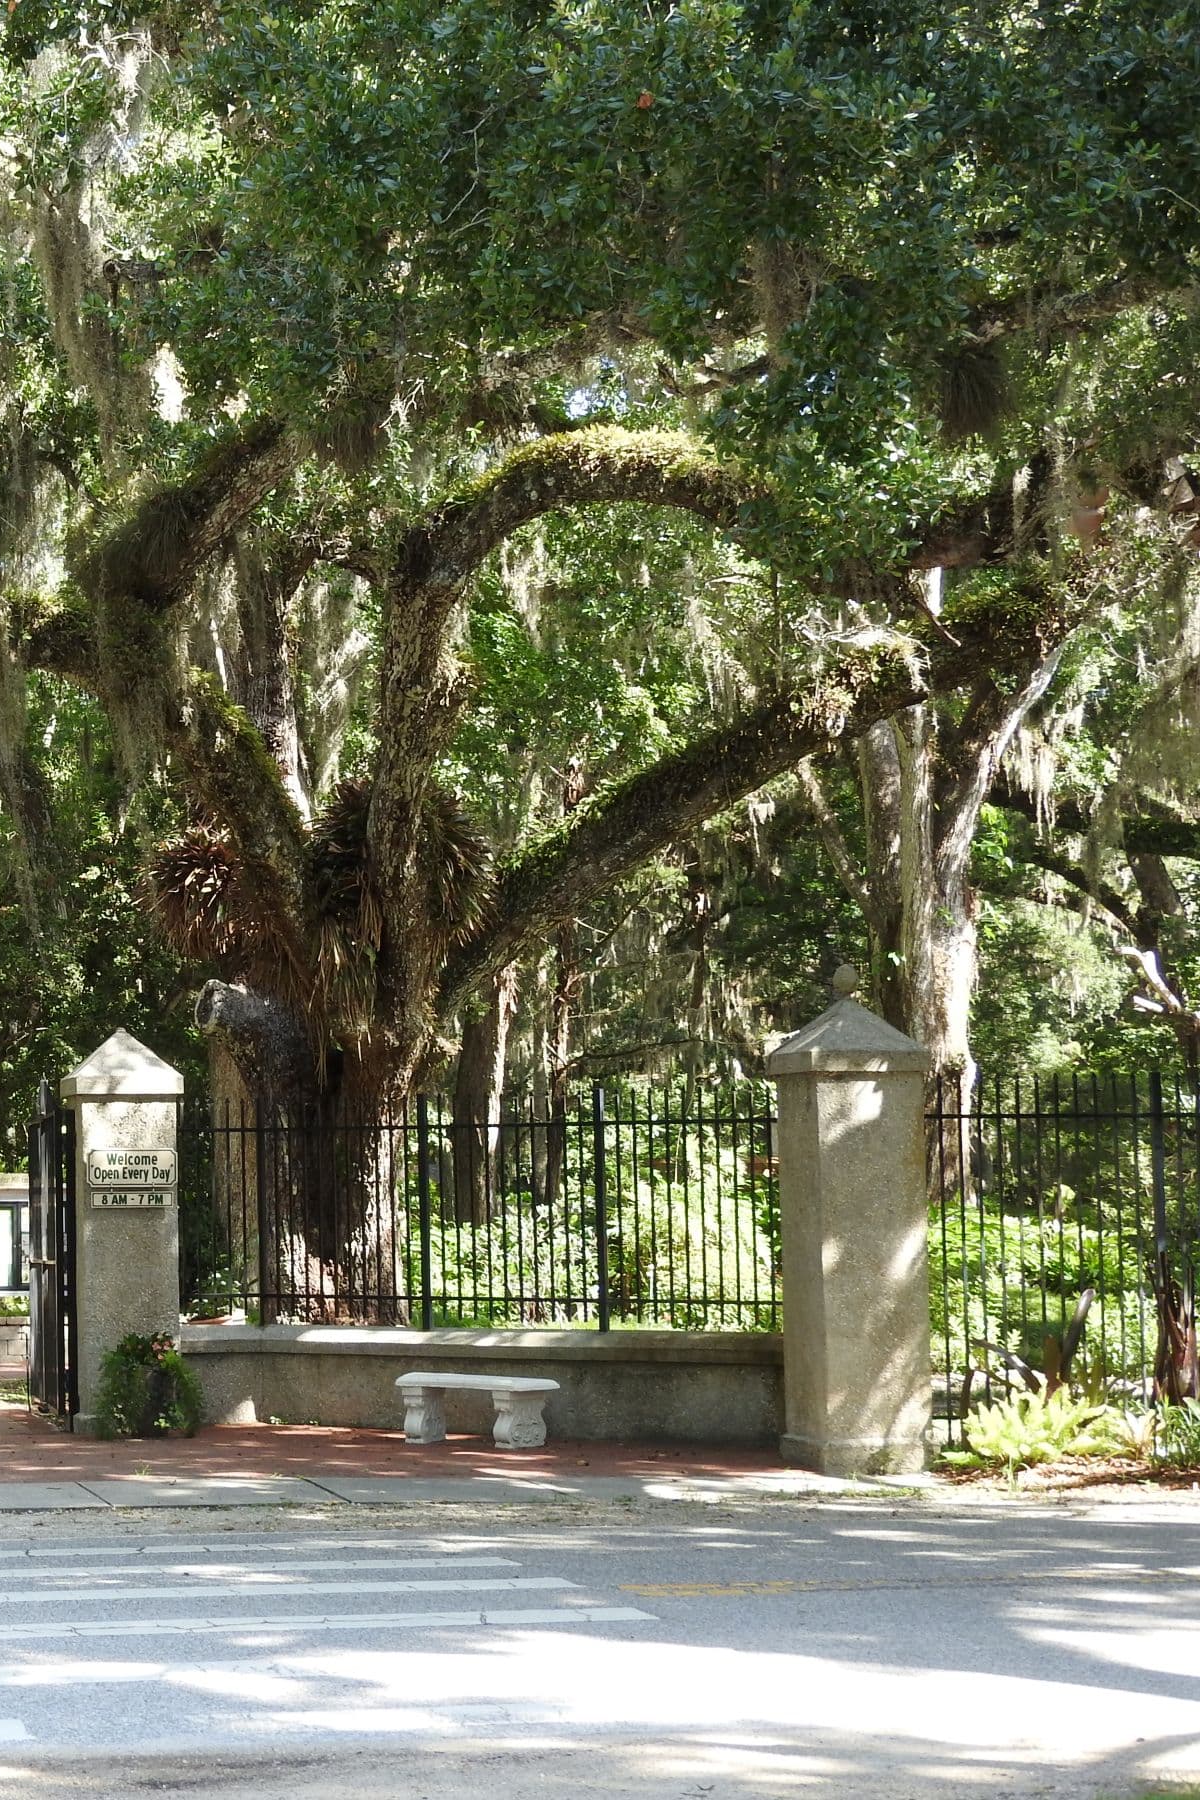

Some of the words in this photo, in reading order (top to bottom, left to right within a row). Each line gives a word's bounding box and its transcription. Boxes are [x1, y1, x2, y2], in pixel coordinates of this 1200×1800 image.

[106, 1153, 158, 1166] Welcome
[93, 1167, 120, 1182] Open
[122, 1167, 149, 1182] Every
[152, 1167, 171, 1182] Day
[101, 1194, 108, 1205] 8
[111, 1194, 128, 1205] AM
[138, 1194, 145, 1205] 7
[147, 1194, 164, 1205] PM
